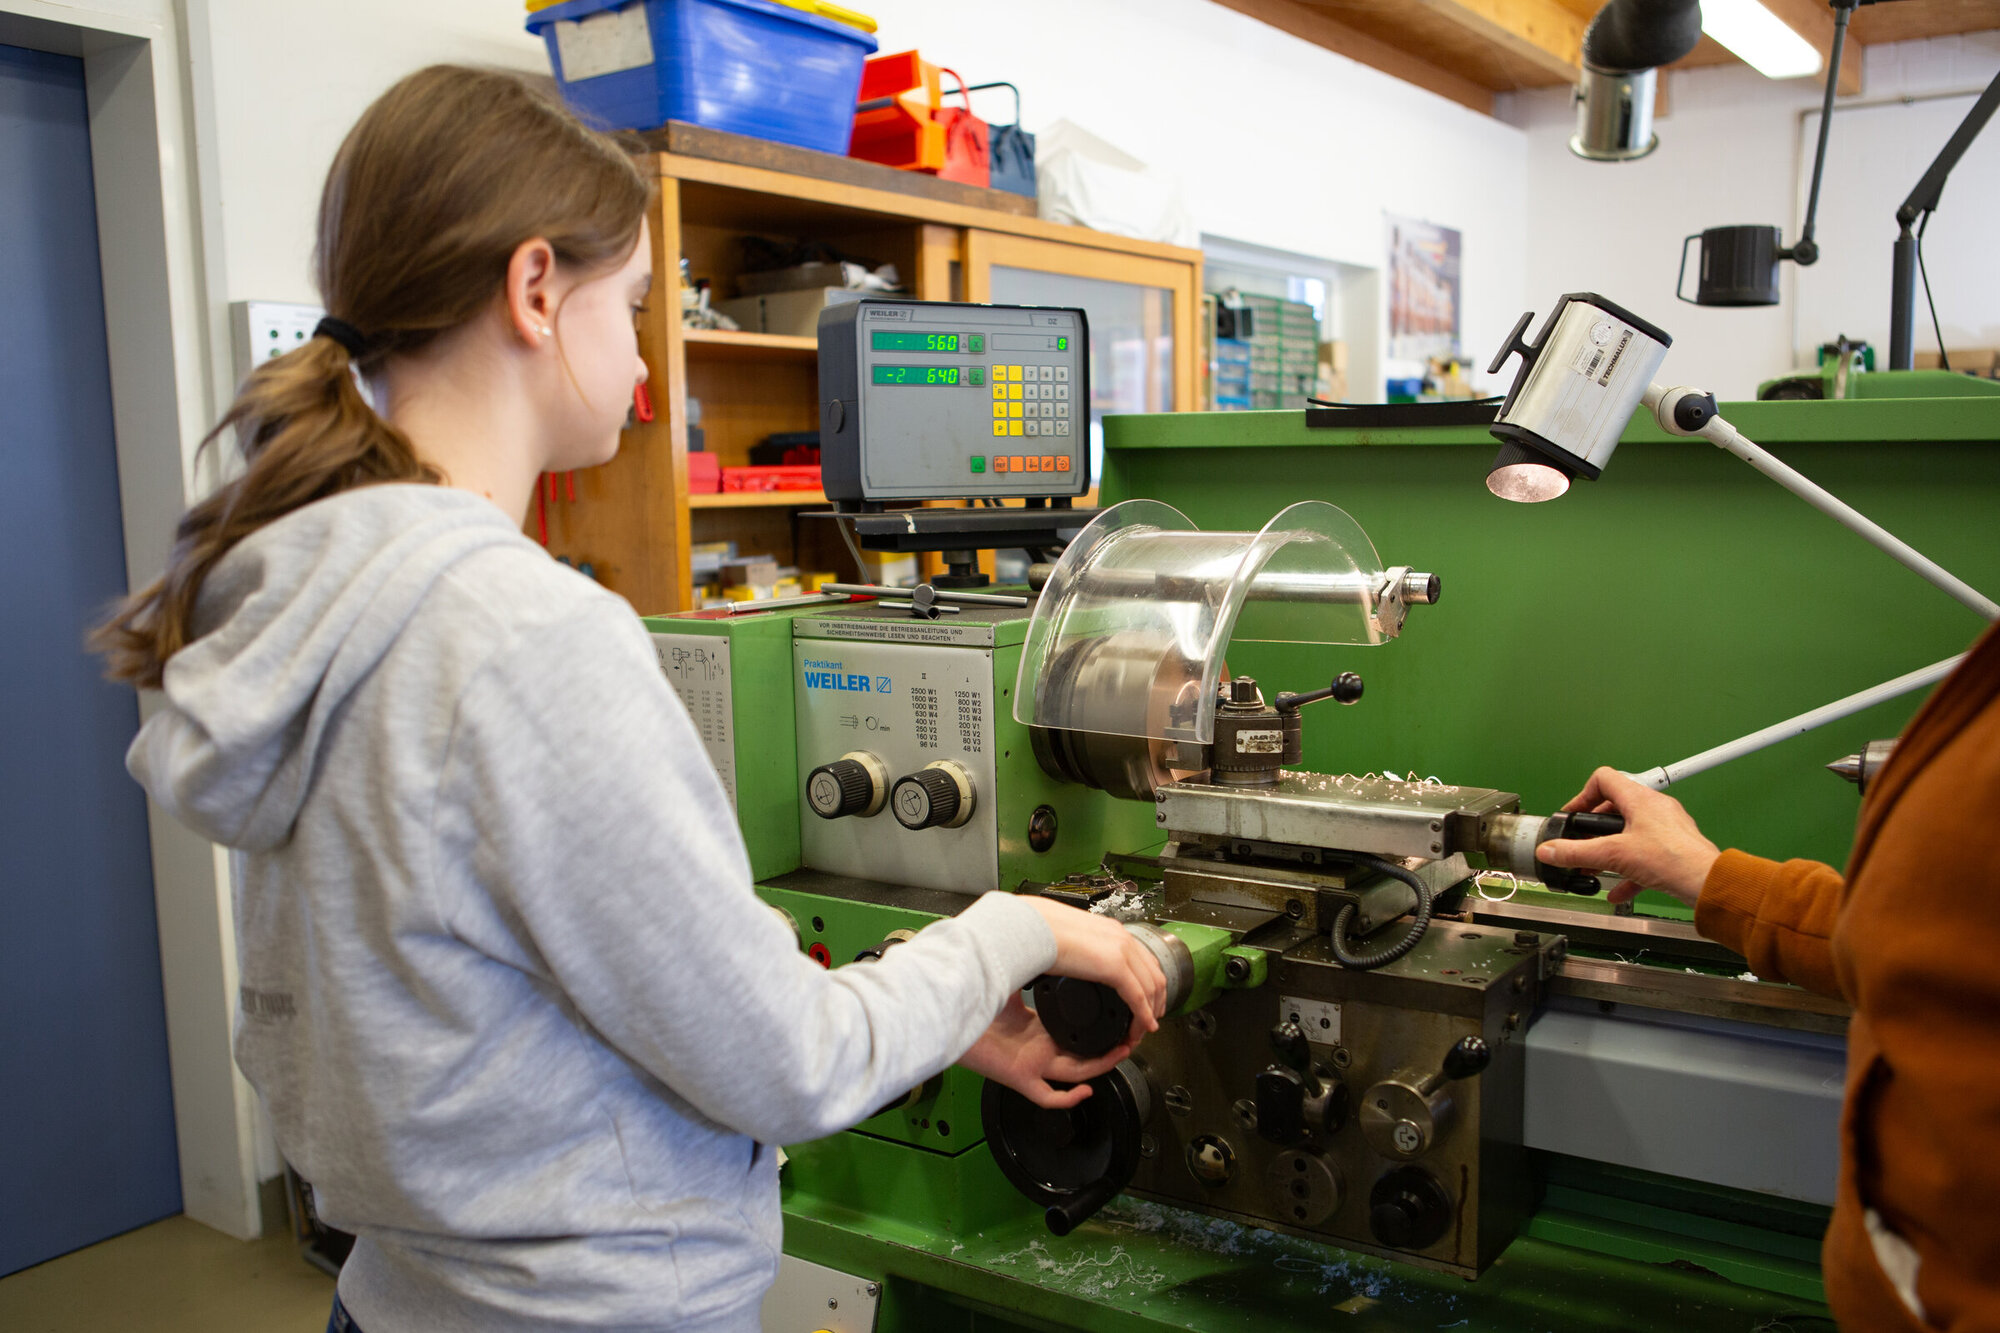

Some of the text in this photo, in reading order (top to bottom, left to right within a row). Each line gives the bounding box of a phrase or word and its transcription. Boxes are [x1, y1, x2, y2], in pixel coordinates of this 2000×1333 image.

[927, 335, 957, 350] 560
[1602, 337, 1628, 379] TECHMALUX
[887, 368, 958, 383] -2 640
[832, 623, 878, 631] INBETRIEBNAHME
[891, 626, 948, 635] BETRIEBSANLEITUNG
[826, 629, 886, 639] SICHERHEITSHINWEISE
[888, 632, 906, 640] LESEN
[921, 634, 951, 642] BEACHTEN
[804, 659, 843, 670] Praktikant
[804, 671, 871, 692] WEILER
[911, 687, 926, 695] 2500
[971, 691, 981, 699] W1
[928, 703, 938, 711] W3
[971, 707, 982, 715] W3
[915, 710, 927, 718] 630
[915, 725, 937, 734] 250 V2
[972, 722, 980, 730] V1
[959, 729, 981, 738] 125 V2
